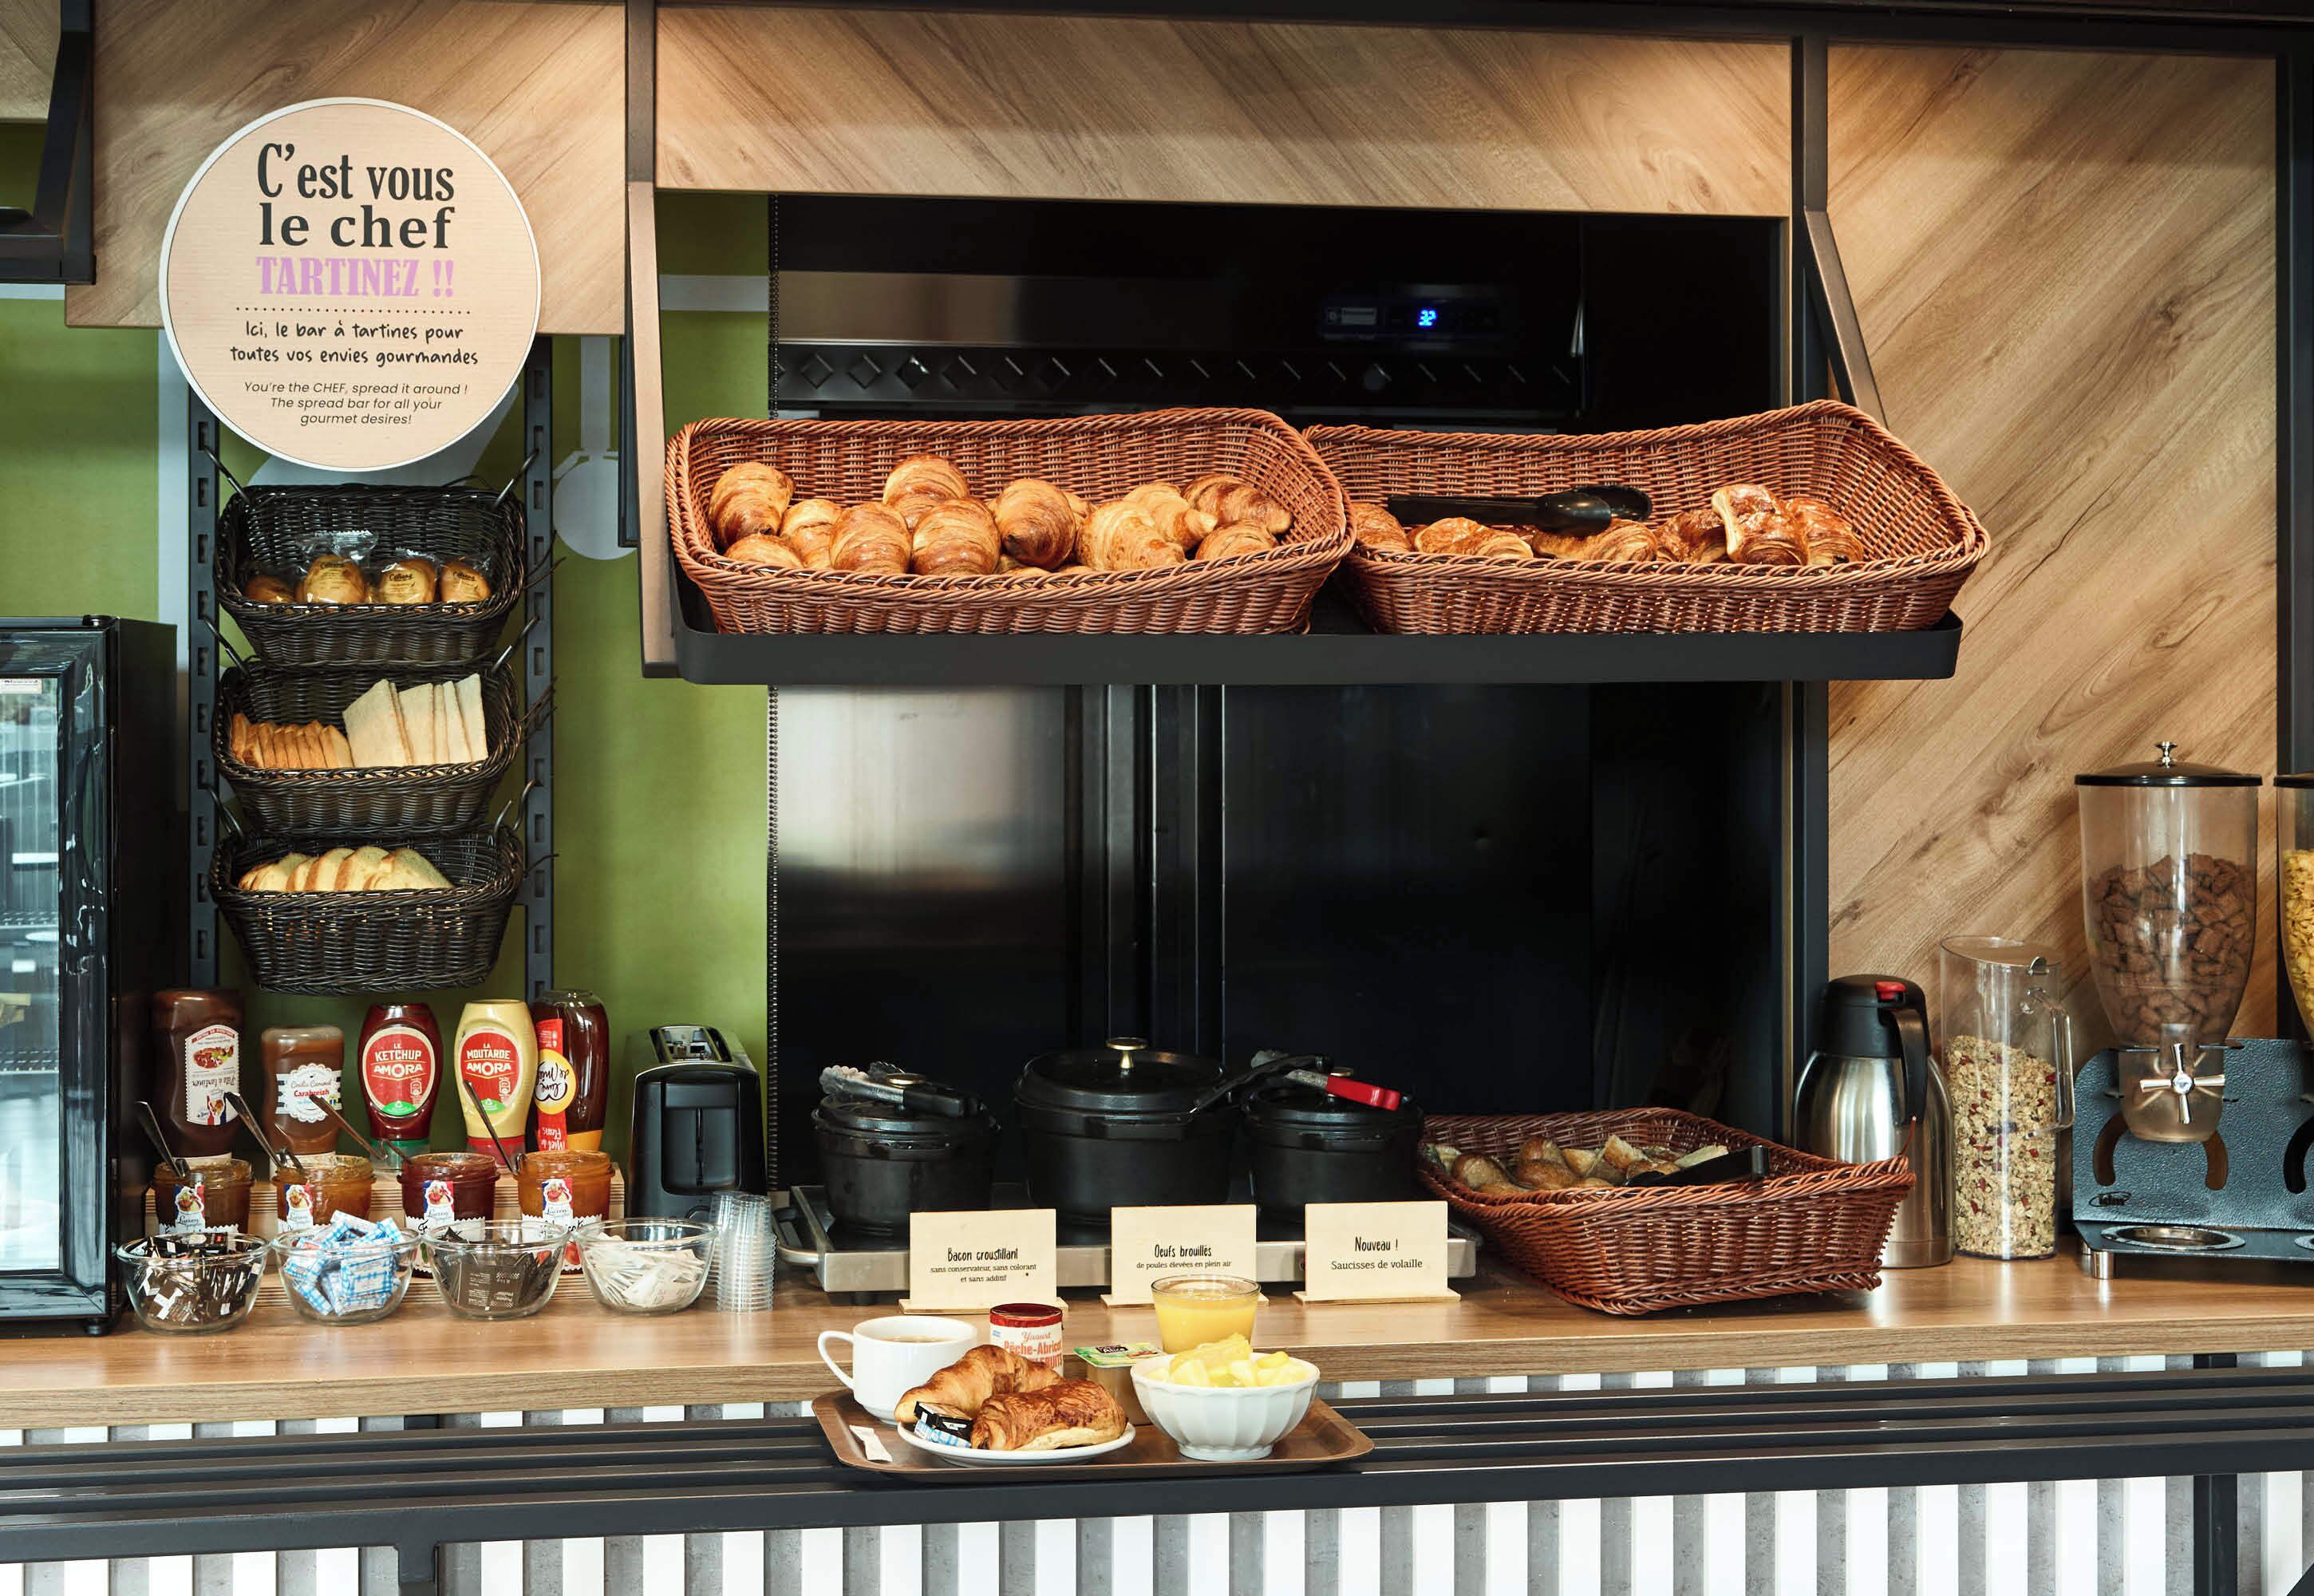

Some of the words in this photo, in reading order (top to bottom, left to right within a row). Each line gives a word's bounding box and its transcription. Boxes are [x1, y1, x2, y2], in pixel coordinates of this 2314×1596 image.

[257, 143, 353, 200] C'est
[365, 167, 455, 201] vous
[259, 202, 310, 247] le
[330, 204, 456, 249] chef
[255, 256, 420, 297] TARTINEZ
[432, 259, 454, 298] !!
[246, 321, 268, 338] Ici,
[275, 321, 289, 338] le
[296, 322, 326, 338] bar
[334, 320, 346, 338] à
[352, 322, 418, 339] tartines
[425, 326, 464, 345] pour
[230, 346, 279, 362] toutes
[286, 349, 313, 362] vos
[320, 348, 369, 363] envies
[376, 348, 479, 368] gourmandes
[288, 382, 310, 393] the
[313, 383, 349, 395] CHEF,
[351, 383, 399, 397] spread
[401, 383, 410, 394] it
[413, 383, 461, 395] around
[464, 385, 468, 394] !
[270, 397, 294, 409] The
[297, 397, 344, 412] spread
[347, 397, 369, 409] bar
[372, 397, 391, 409] for
[394, 398, 410, 410] all
[413, 400, 443, 413] your
[299, 414, 359, 427] gourmet
[361, 414, 413, 425] desires!
[374, 1049, 422, 1062] KETCHUP
[466, 1049, 511, 1060] MOUTARDE
[373, 1063, 424, 1078] AMORA
[466, 1061, 511, 1077] AMORA
[1154, 1243, 1176, 1258] Oeufs
[1179, 1243, 1212, 1257] brouillés
[1355, 1236, 1391, 1251] Nouveau
[1395, 1238, 1399, 1251] !
[947, 1247, 973, 1262] Bacon
[976, 1247, 1019, 1261] croustillant
[1146, 1262, 1167, 1270] poules
[1204, 1260, 1221, 1269] plein
[1330, 1260, 1376, 1270] Saucisses
[1377, 1259, 1388, 1269] de
[1390, 1258, 1424, 1269] volaille
[1021, 1330, 1052, 1343] Yaourt
